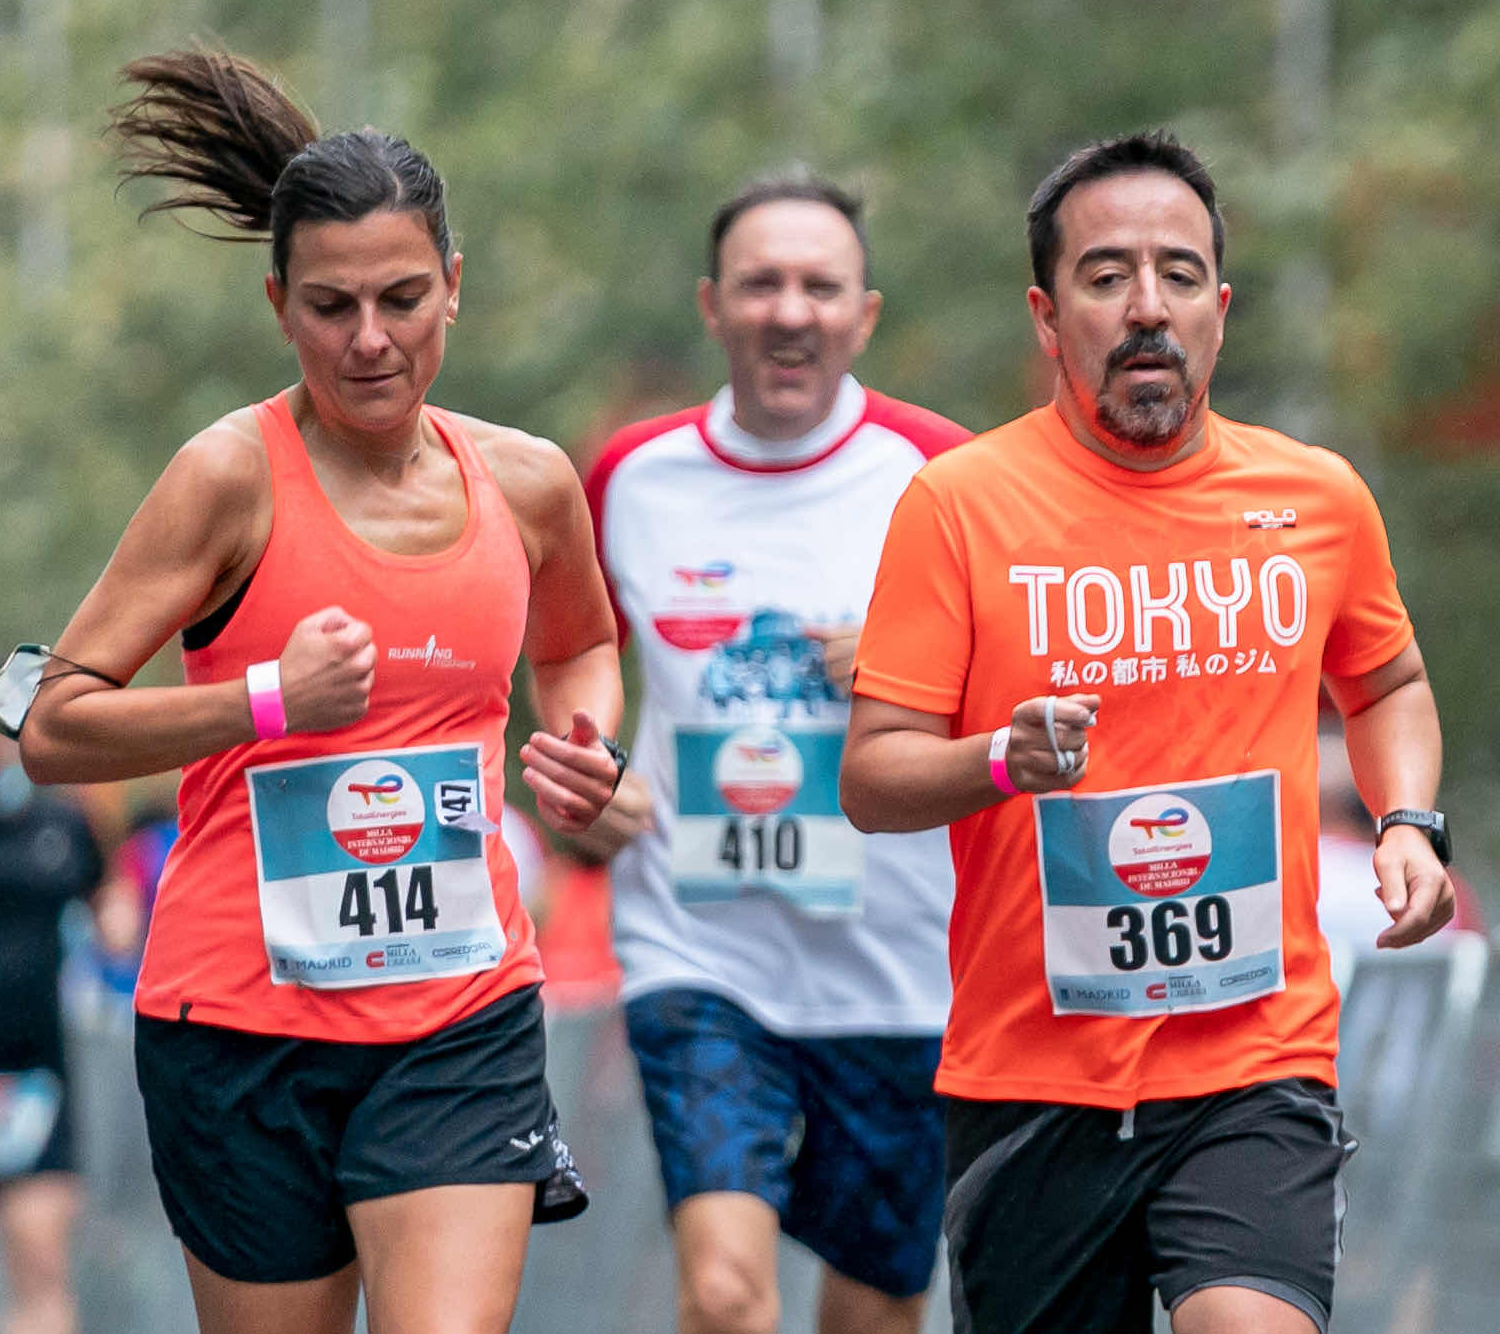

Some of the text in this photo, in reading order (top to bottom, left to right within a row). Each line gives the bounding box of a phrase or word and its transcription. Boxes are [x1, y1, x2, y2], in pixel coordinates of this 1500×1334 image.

[1244, 508, 1297, 523] POLO
[1009, 554, 1307, 656] TOKYO
[1050, 649, 1278, 688] 私の都市 私のジム
[717, 818, 804, 871] 410
[339, 865, 439, 937] 414
[1106, 894, 1233, 971] 369
[295, 956, 353, 971] MADRID
[1075, 987, 1131, 1001] MADRID
